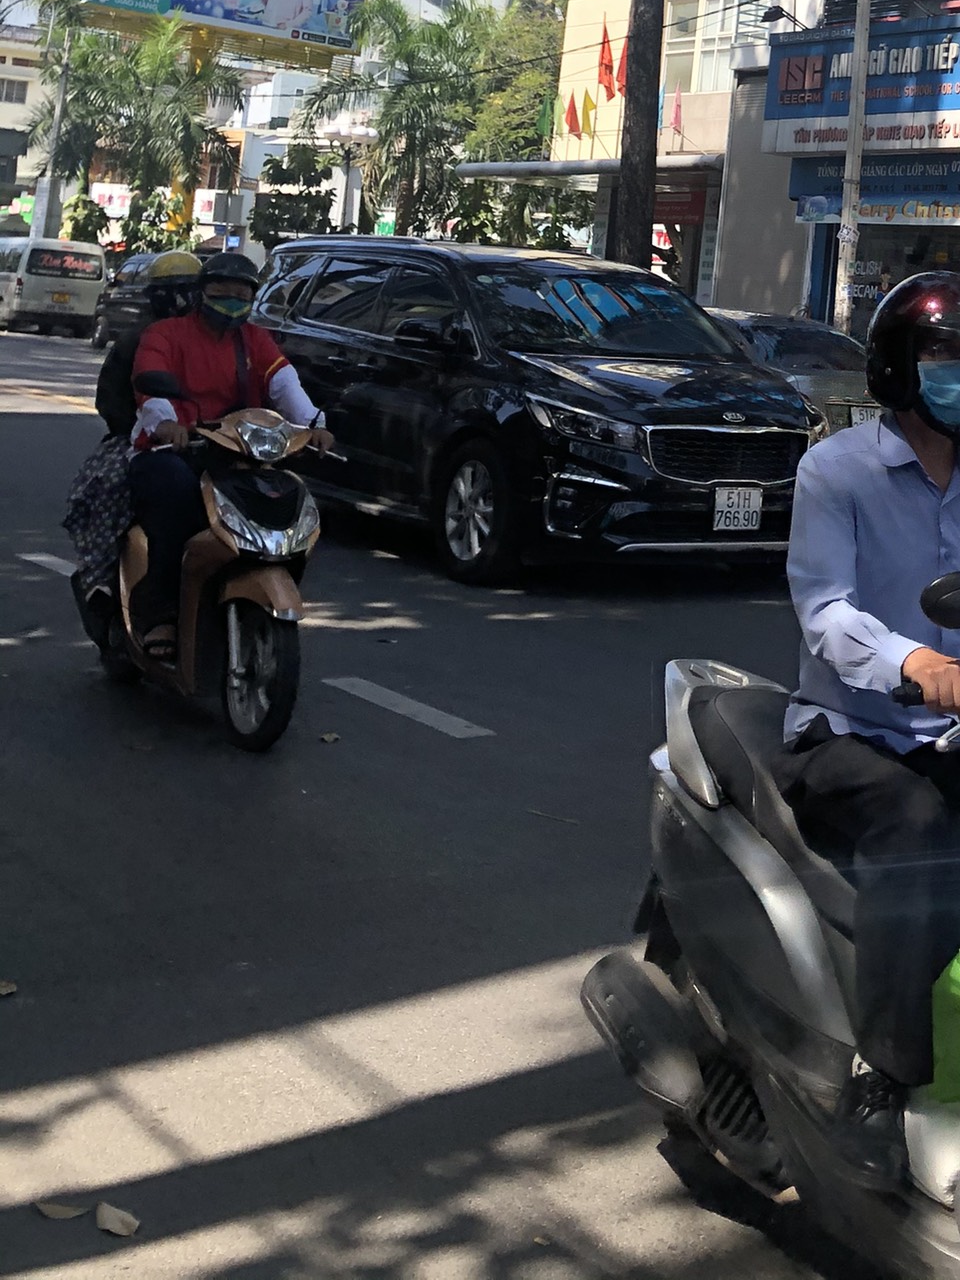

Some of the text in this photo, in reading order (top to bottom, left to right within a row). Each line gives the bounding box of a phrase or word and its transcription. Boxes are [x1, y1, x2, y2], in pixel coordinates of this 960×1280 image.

[888, 46, 922, 74] GIAO
[926, 33, 960, 72] TIẾP
[779, 92, 821, 104] LEECAM
[831, 90, 844, 102] THE
[904, 86, 934, 98] SCHOOL
[903, 124, 926, 140] GIAO
[928, 119, 950, 139] TIẾP
[860, 204, 898, 222] erry
[858, 409, 876, 420] 51H
[726, 492, 752, 509] 51H
[716, 510, 758, 528] 766.90
